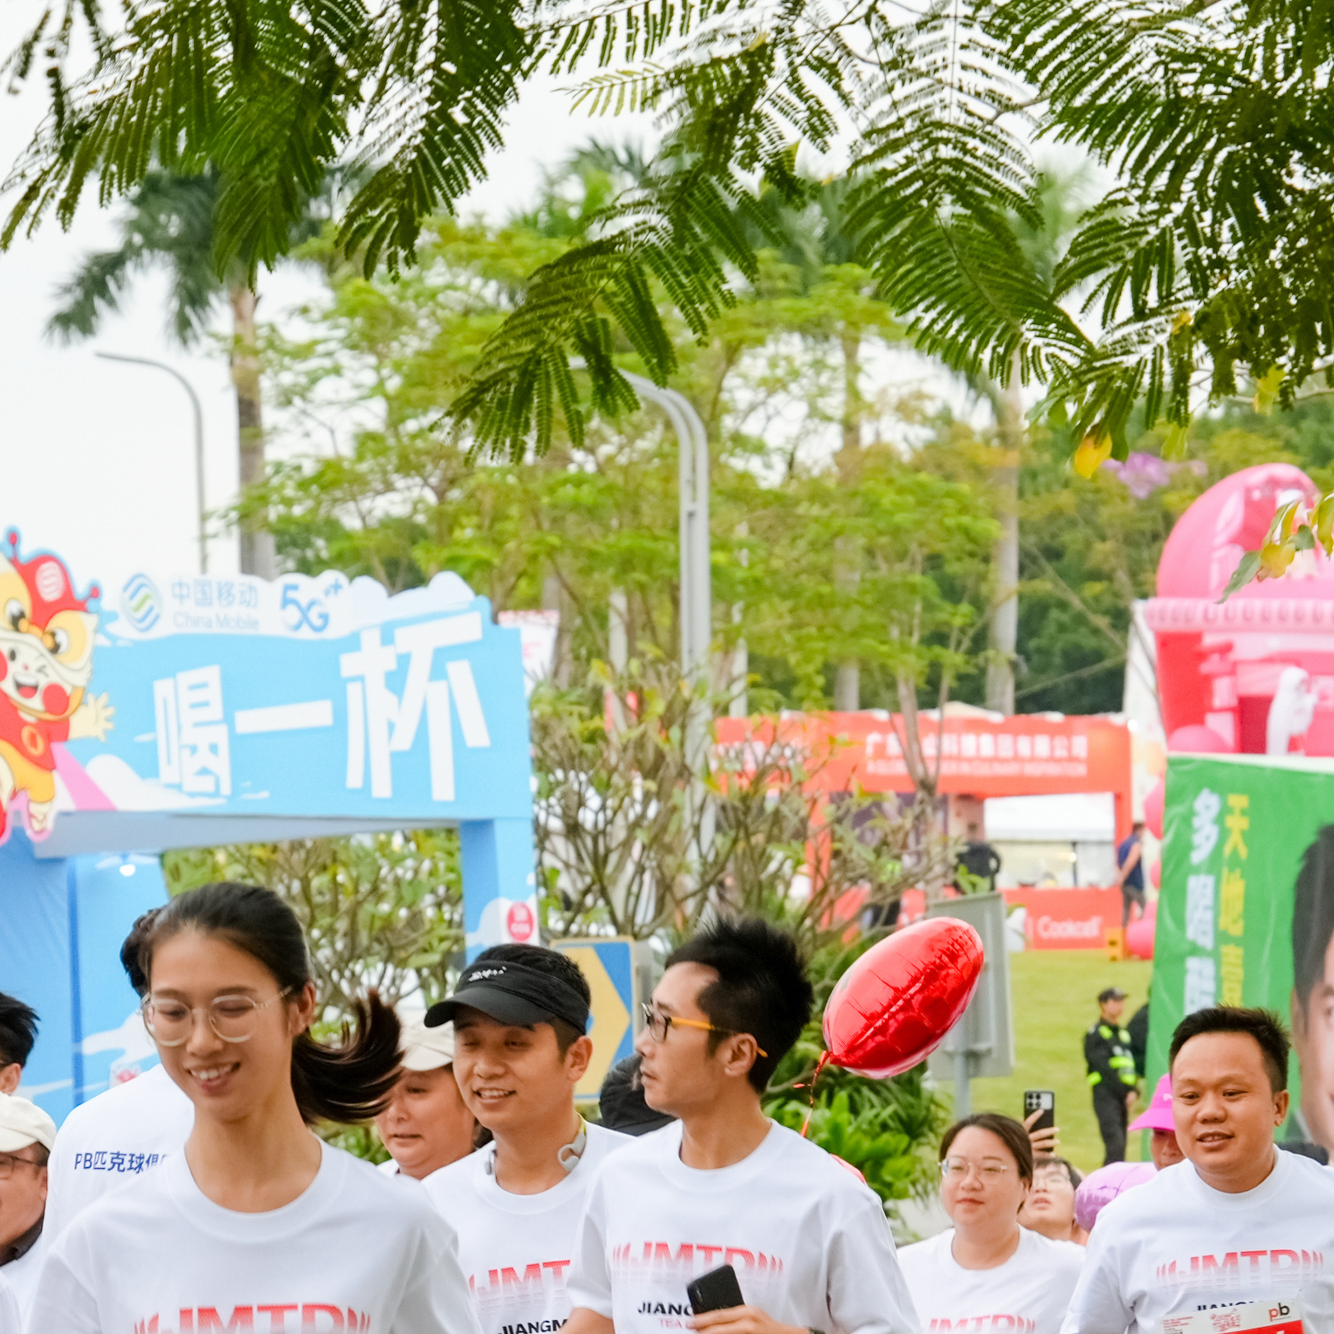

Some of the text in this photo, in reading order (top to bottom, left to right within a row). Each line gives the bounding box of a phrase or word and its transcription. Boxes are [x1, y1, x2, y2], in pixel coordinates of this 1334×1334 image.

[170, 577, 260, 608] 中国移动
[173, 611, 260, 631] China Mobile
